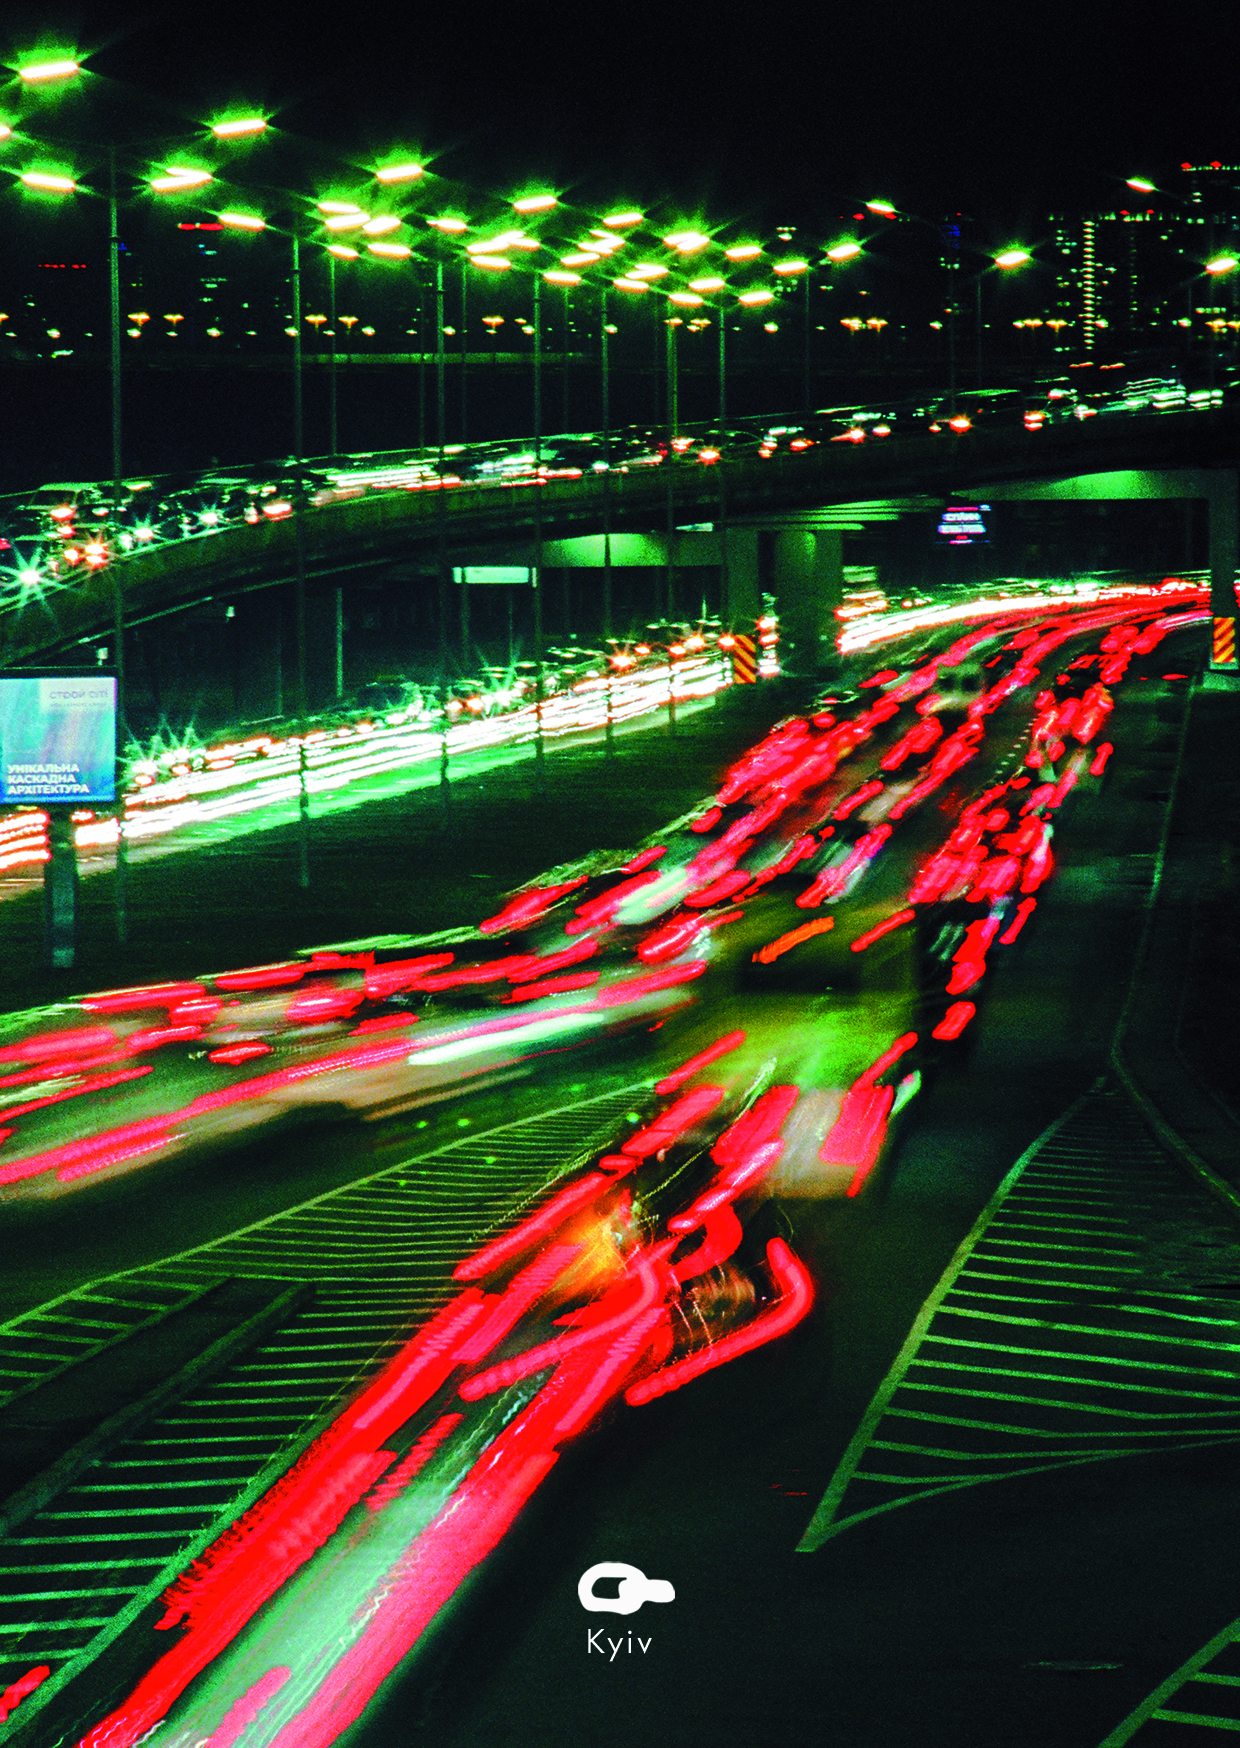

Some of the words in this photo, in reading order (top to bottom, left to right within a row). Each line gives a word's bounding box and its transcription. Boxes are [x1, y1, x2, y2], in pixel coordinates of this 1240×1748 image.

[7, 763, 80, 774] УНІКАЛЬНА
[7, 774, 77, 784] КАСКАДНА
[7, 784, 90, 795] АРХІТЕКТУРА
